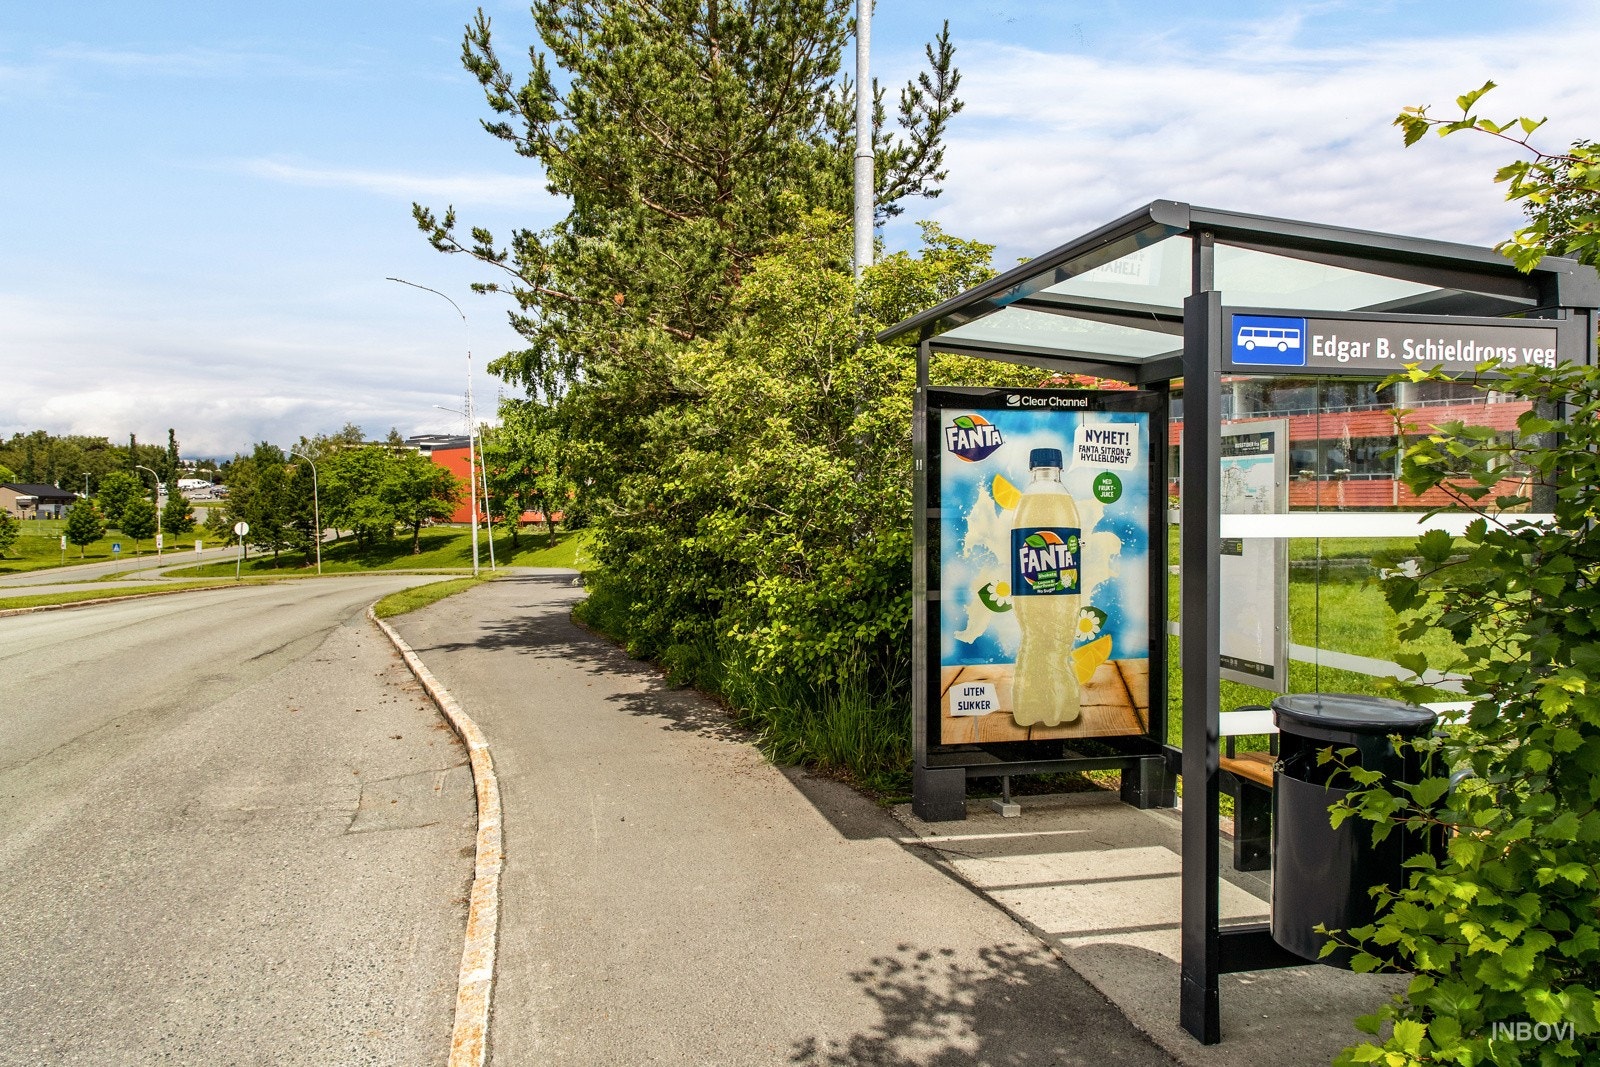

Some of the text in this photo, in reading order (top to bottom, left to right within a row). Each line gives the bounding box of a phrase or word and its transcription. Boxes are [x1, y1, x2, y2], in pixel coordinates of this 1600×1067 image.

[1312, 335, 1557, 369] Edgar B. Schieldrops veg
[1021, 396, 1088, 407] Clear Channel
[946, 425, 1003, 451] FANTA
[1085, 429, 1129, 446] NYHET!
[1078, 444, 1132, 457] FANTA SITRON &
[1080, 452, 1129, 464] HYLLEBLOMST
[1019, 544, 1073, 574] FANTA
[963, 687, 985, 697] UTEN
[957, 700, 991, 711] SUKKER
